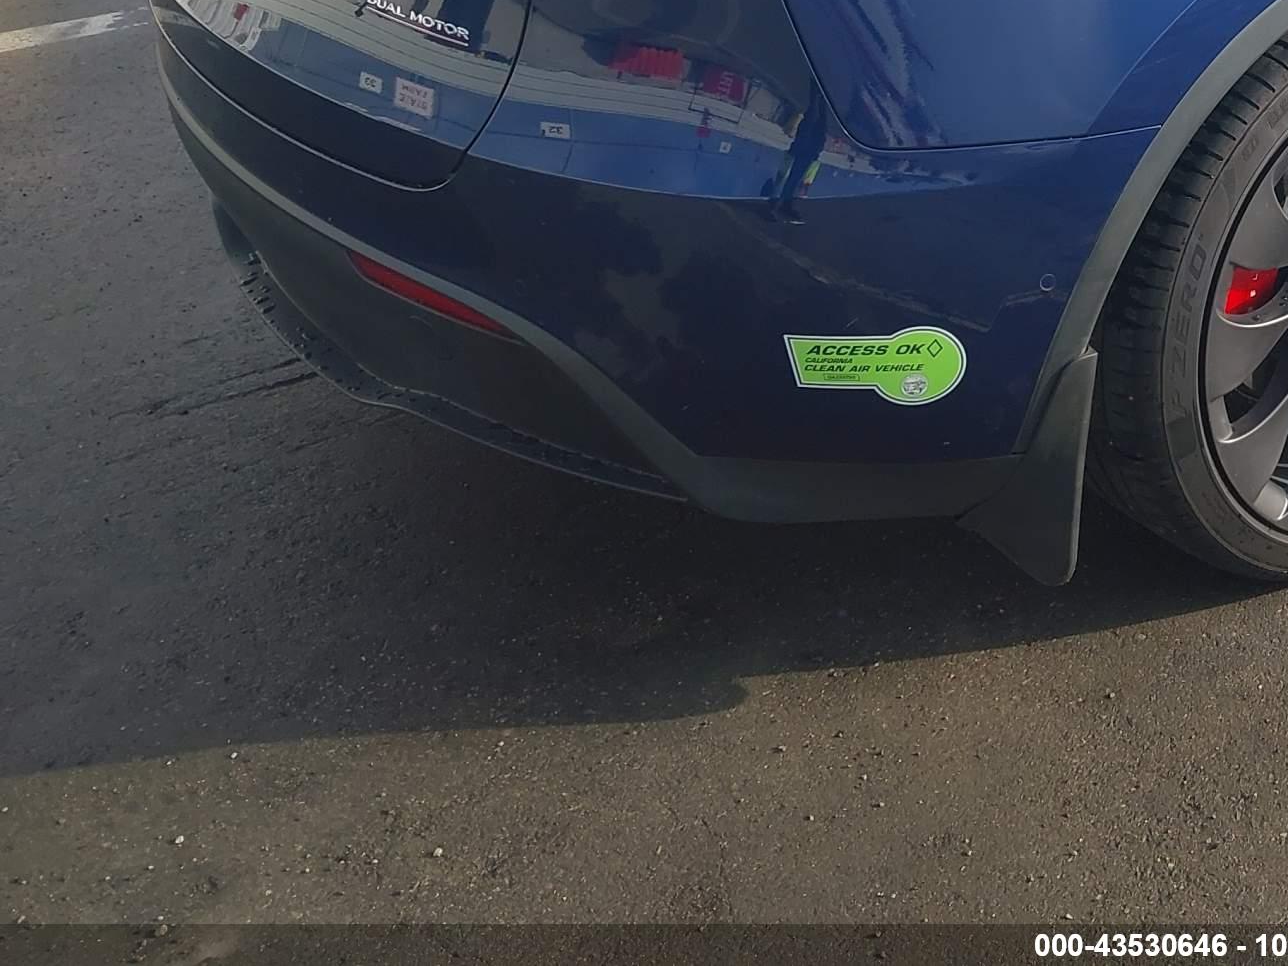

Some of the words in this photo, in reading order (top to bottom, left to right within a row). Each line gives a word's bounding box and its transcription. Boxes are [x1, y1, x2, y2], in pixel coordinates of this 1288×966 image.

[410, 10, 469, 40] MOTOR
[806, 344, 889, 356] ACCESS
[895, 343, 926, 356] OK
[804, 364, 846, 373] CLEAN
[848, 365, 871, 373] AIR
[875, 363, 925, 372] VEHICLE
